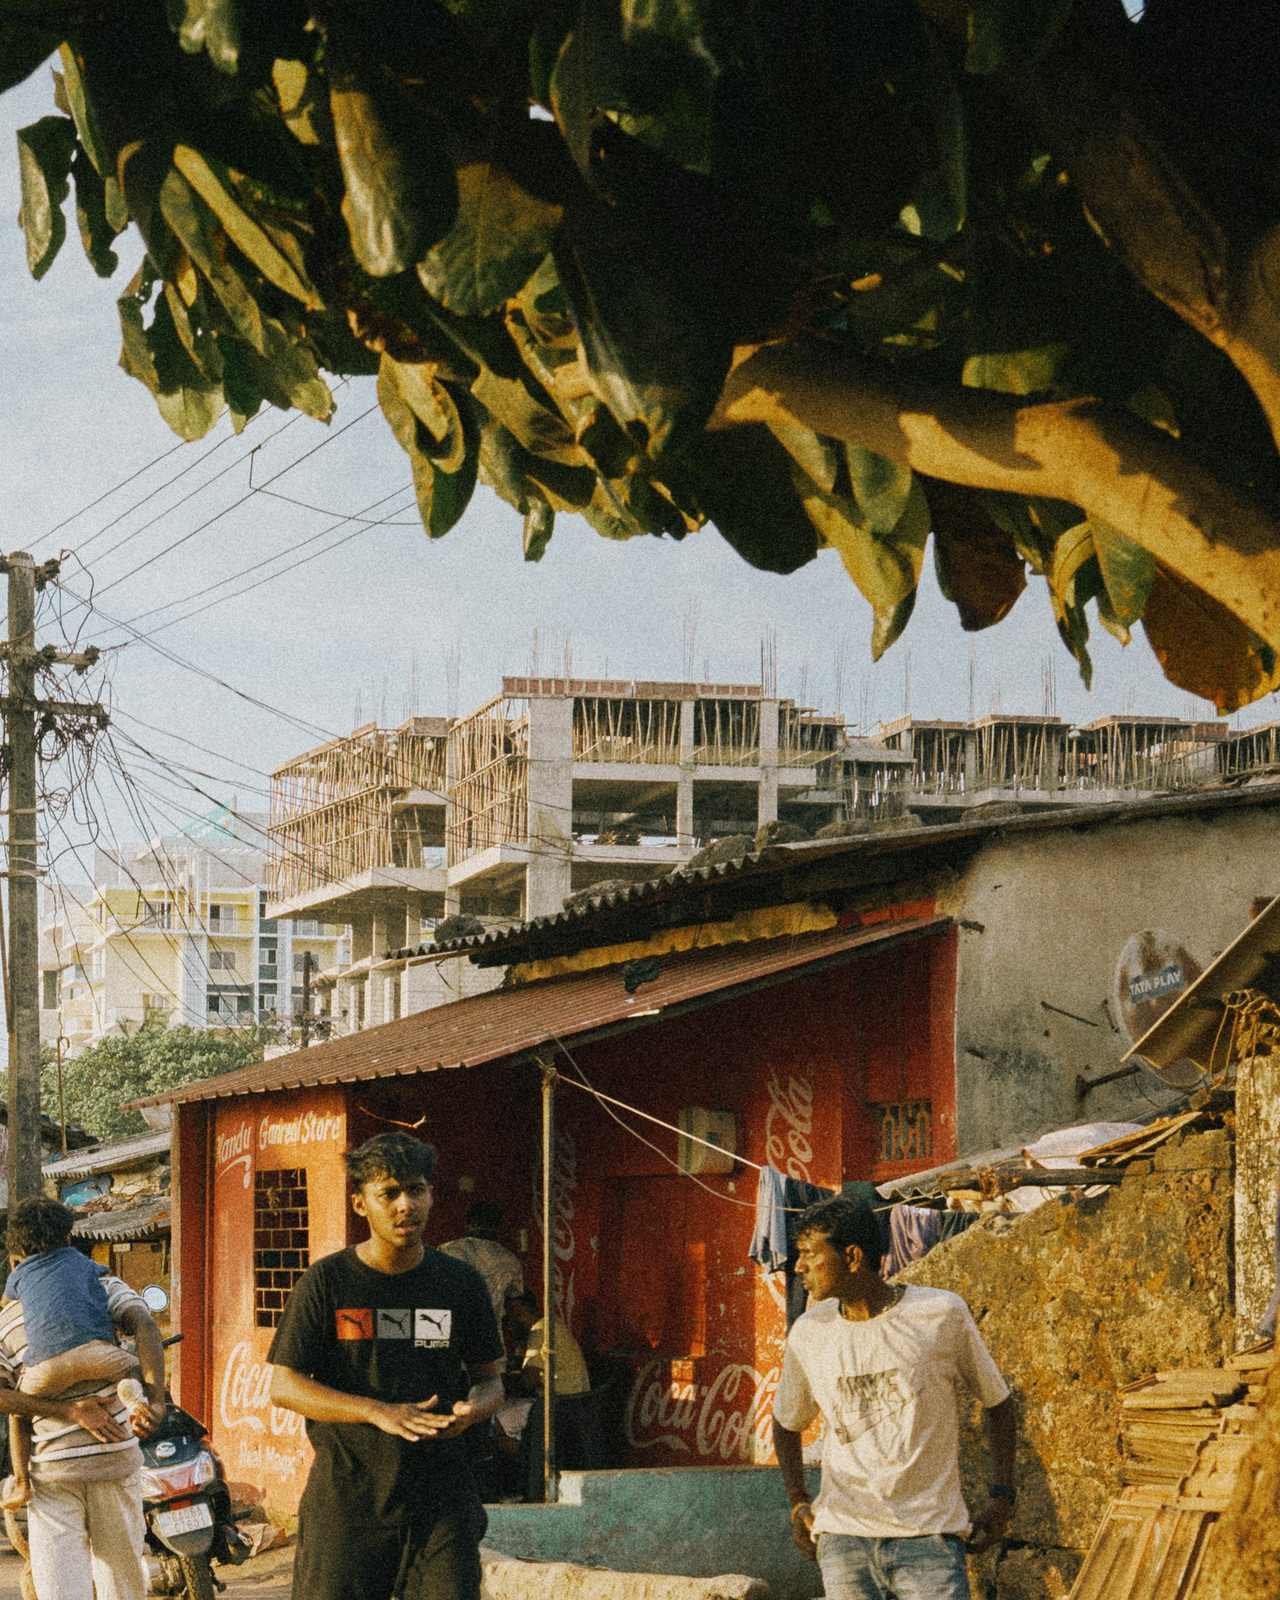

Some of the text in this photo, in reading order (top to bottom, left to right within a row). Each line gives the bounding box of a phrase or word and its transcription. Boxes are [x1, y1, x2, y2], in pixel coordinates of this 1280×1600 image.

[1129, 970, 1182, 996] TATA PLAY
[302, 1110, 341, 1144] Store
[414, 1339, 450, 1349] PUMA
